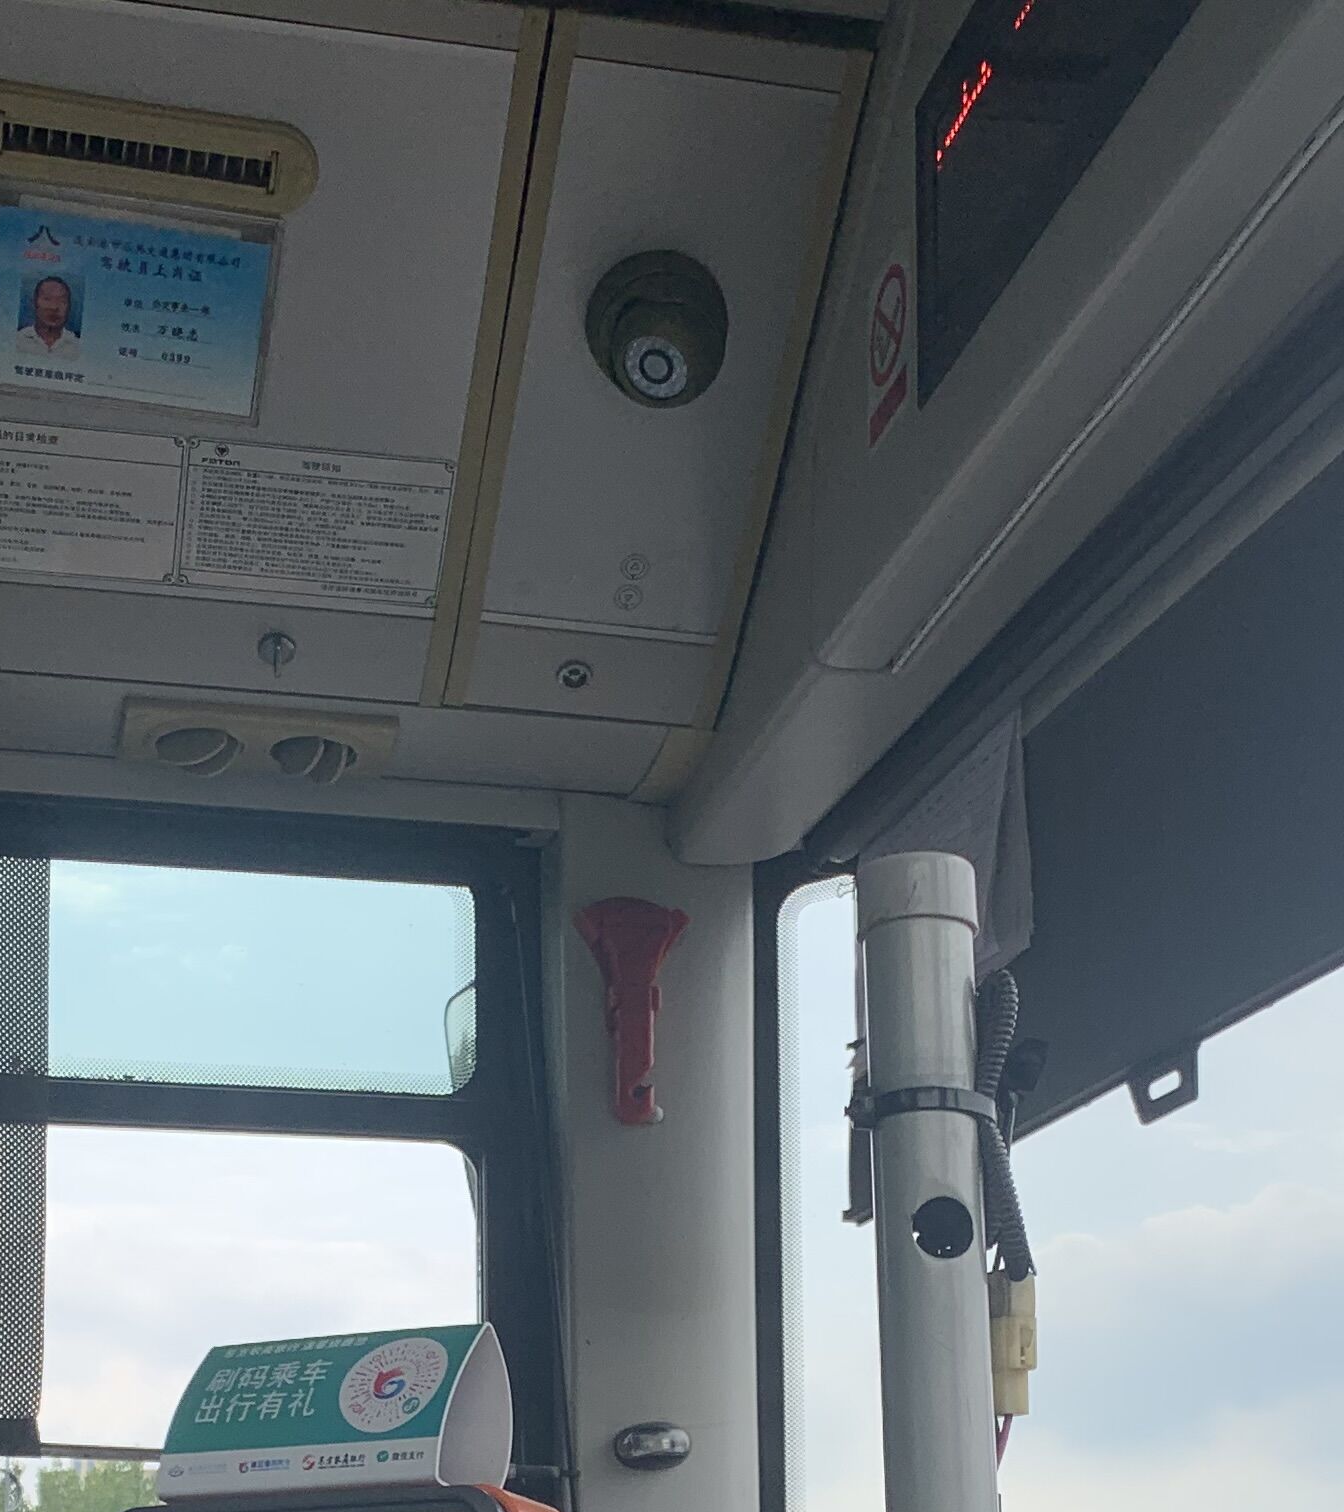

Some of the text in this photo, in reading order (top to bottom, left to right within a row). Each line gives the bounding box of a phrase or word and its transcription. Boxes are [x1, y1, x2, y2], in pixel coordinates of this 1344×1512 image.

[206, 1359, 333, 1394] 刷码乘车
[194, 1387, 316, 1425] 出行有礼
